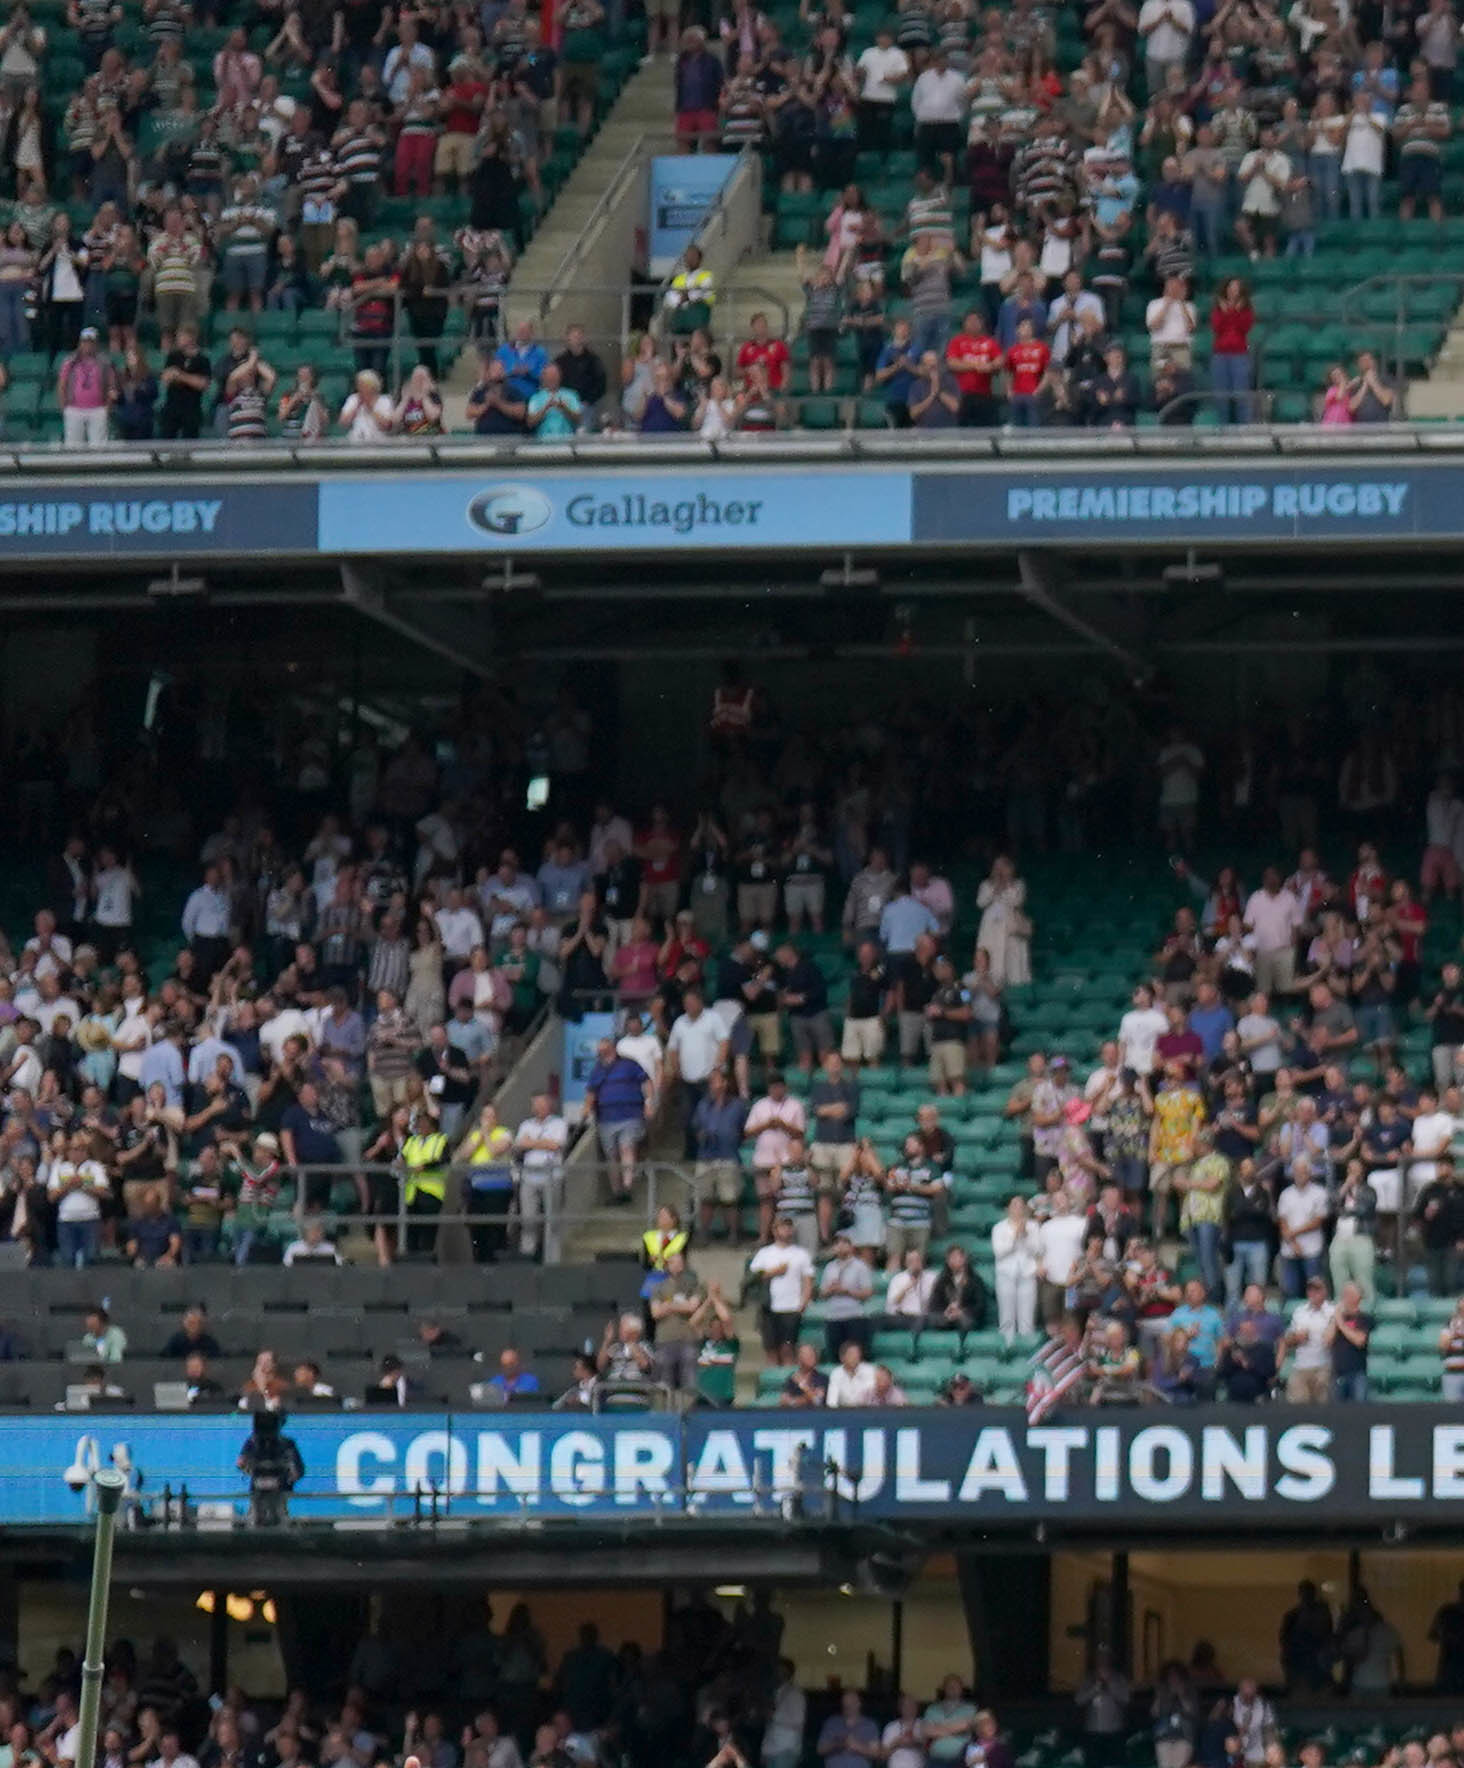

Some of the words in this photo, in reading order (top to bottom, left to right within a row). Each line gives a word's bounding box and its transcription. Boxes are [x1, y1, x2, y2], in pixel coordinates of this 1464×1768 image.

[90, 500, 222, 533] RUGBY
[566, 487, 763, 533] Gallagher
[1009, 485, 1267, 521] PREMIERSHIP
[1274, 482, 1408, 517] RUGBY
[335, 1424, 1336, 1506] CONGRATULATIONS
